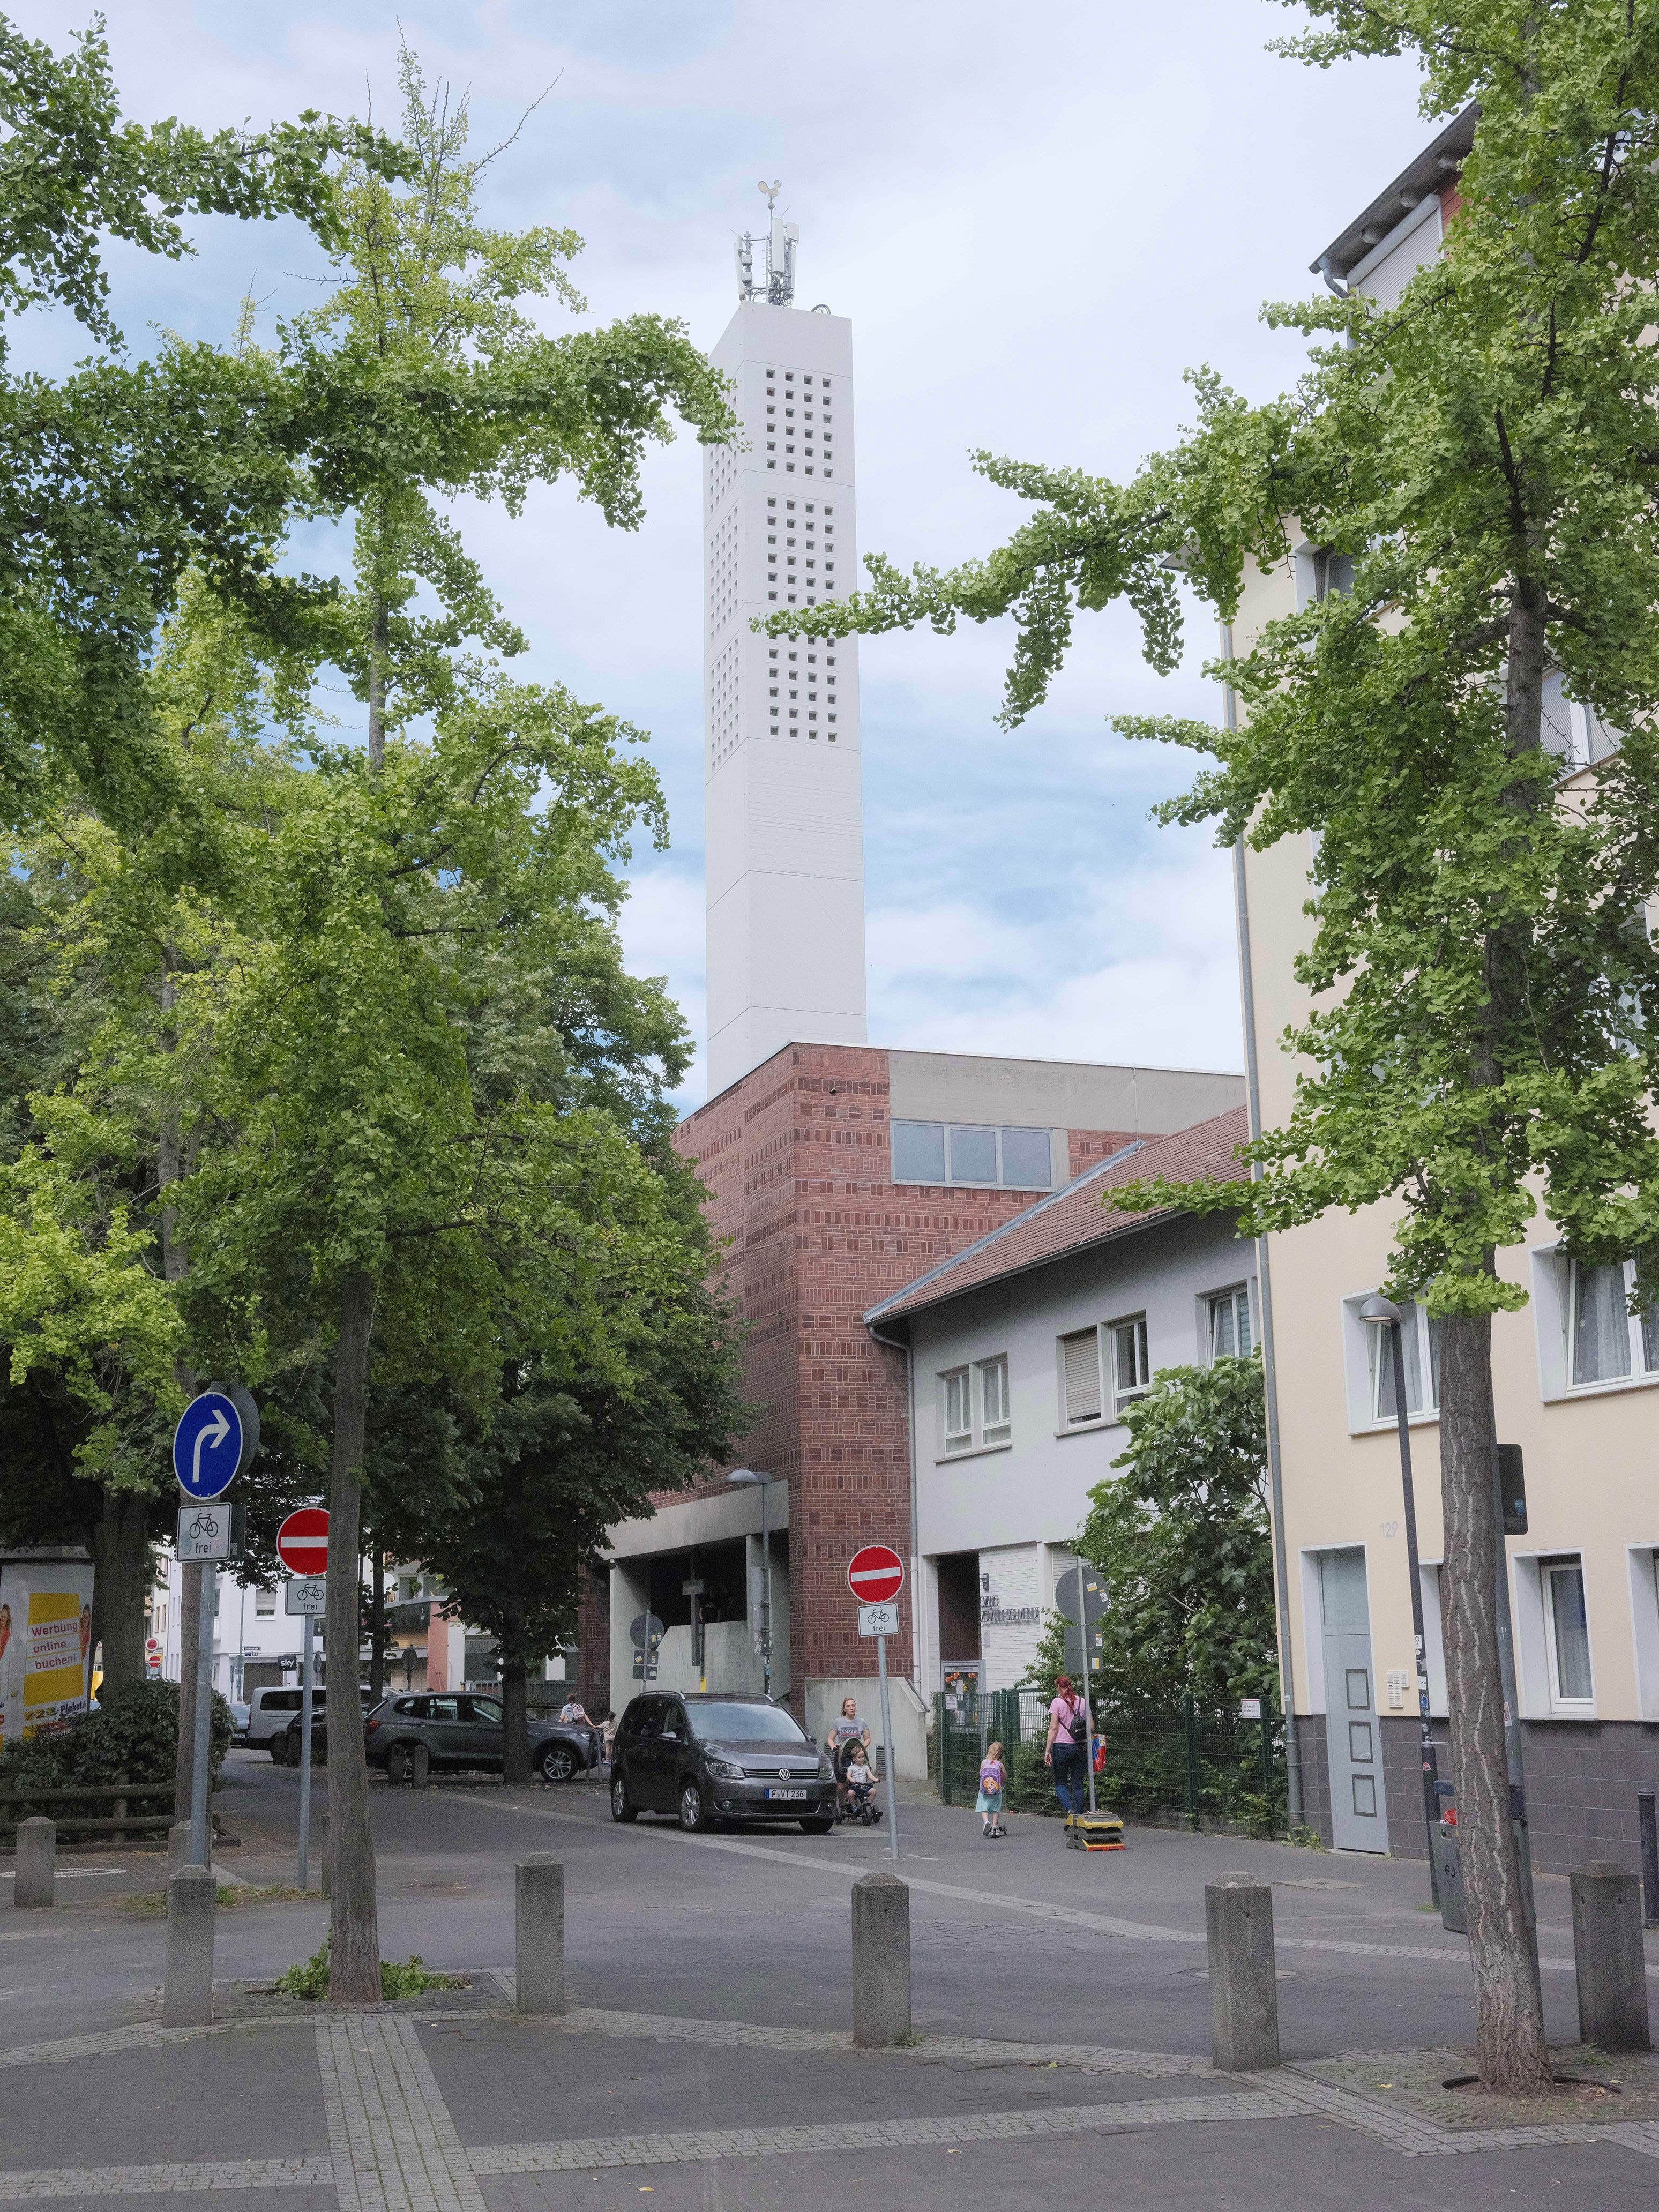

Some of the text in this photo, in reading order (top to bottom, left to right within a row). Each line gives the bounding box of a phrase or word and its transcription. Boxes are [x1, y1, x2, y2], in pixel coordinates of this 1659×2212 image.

[1380, 1521, 1398, 1538] 129
[195, 1542, 212, 1553] frei
[31, 1622, 78, 1637] Werbung
[33, 1640, 66, 1653] online
[35, 1653, 76, 1670] buchen!
[280, 1658, 294, 1668] sky
